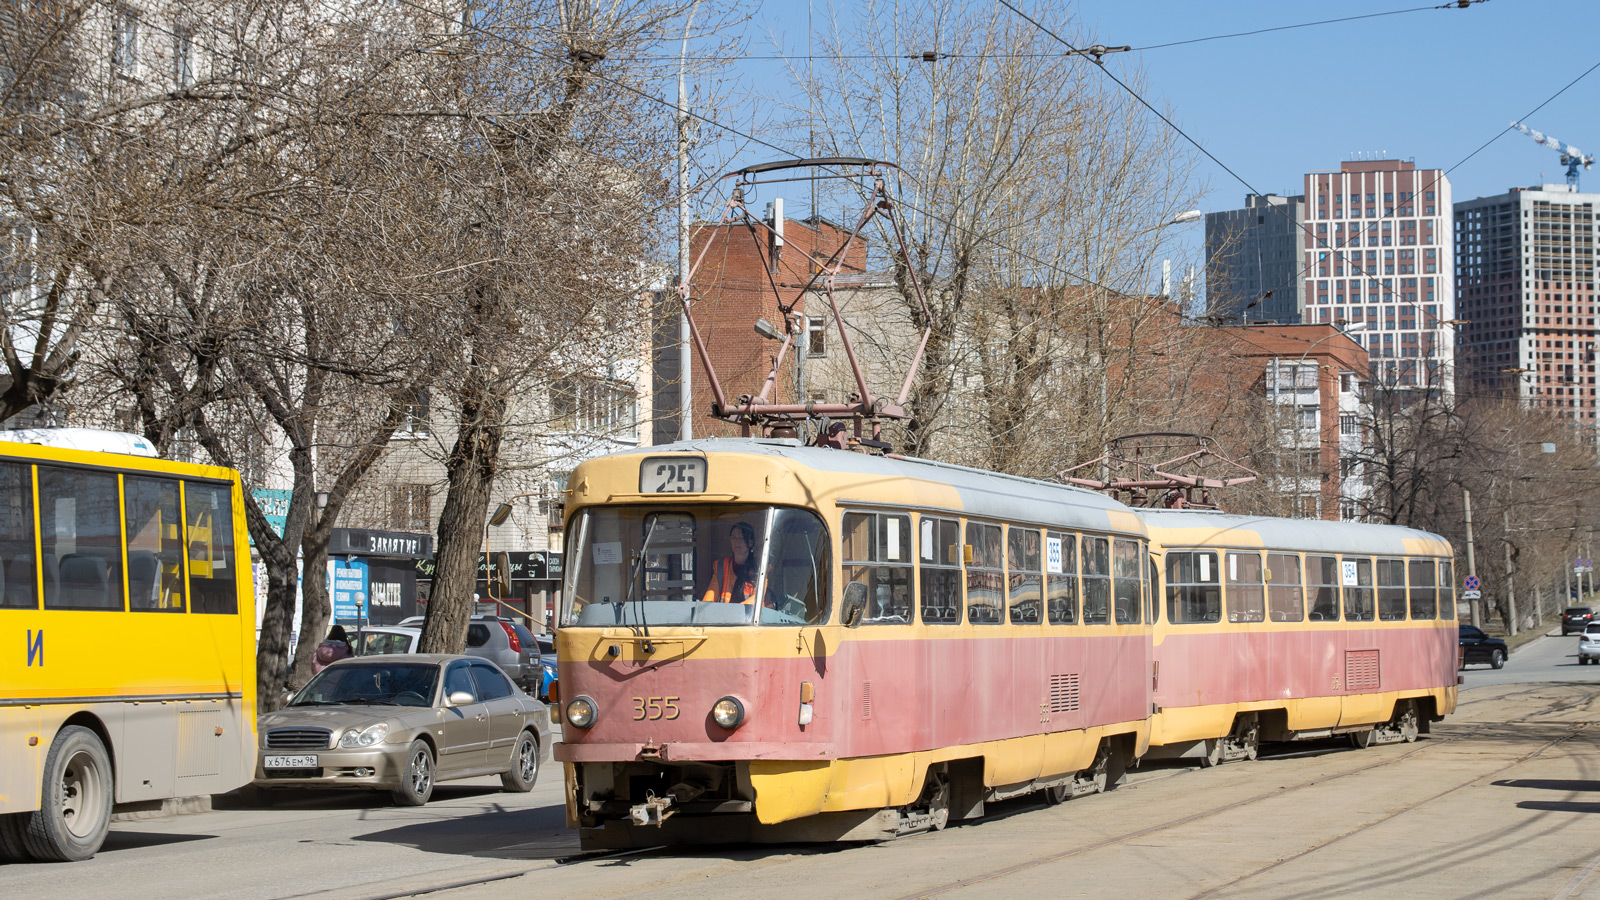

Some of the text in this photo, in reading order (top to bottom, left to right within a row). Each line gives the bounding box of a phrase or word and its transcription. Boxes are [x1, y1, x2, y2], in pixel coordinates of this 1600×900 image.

[656, 464, 695, 493] 25
[370, 537, 417, 554] ЗАКЛЯТИЕ
[1049, 541, 1060, 563] 355
[27, 629, 43, 667] И
[632, 696, 680, 721] 355
